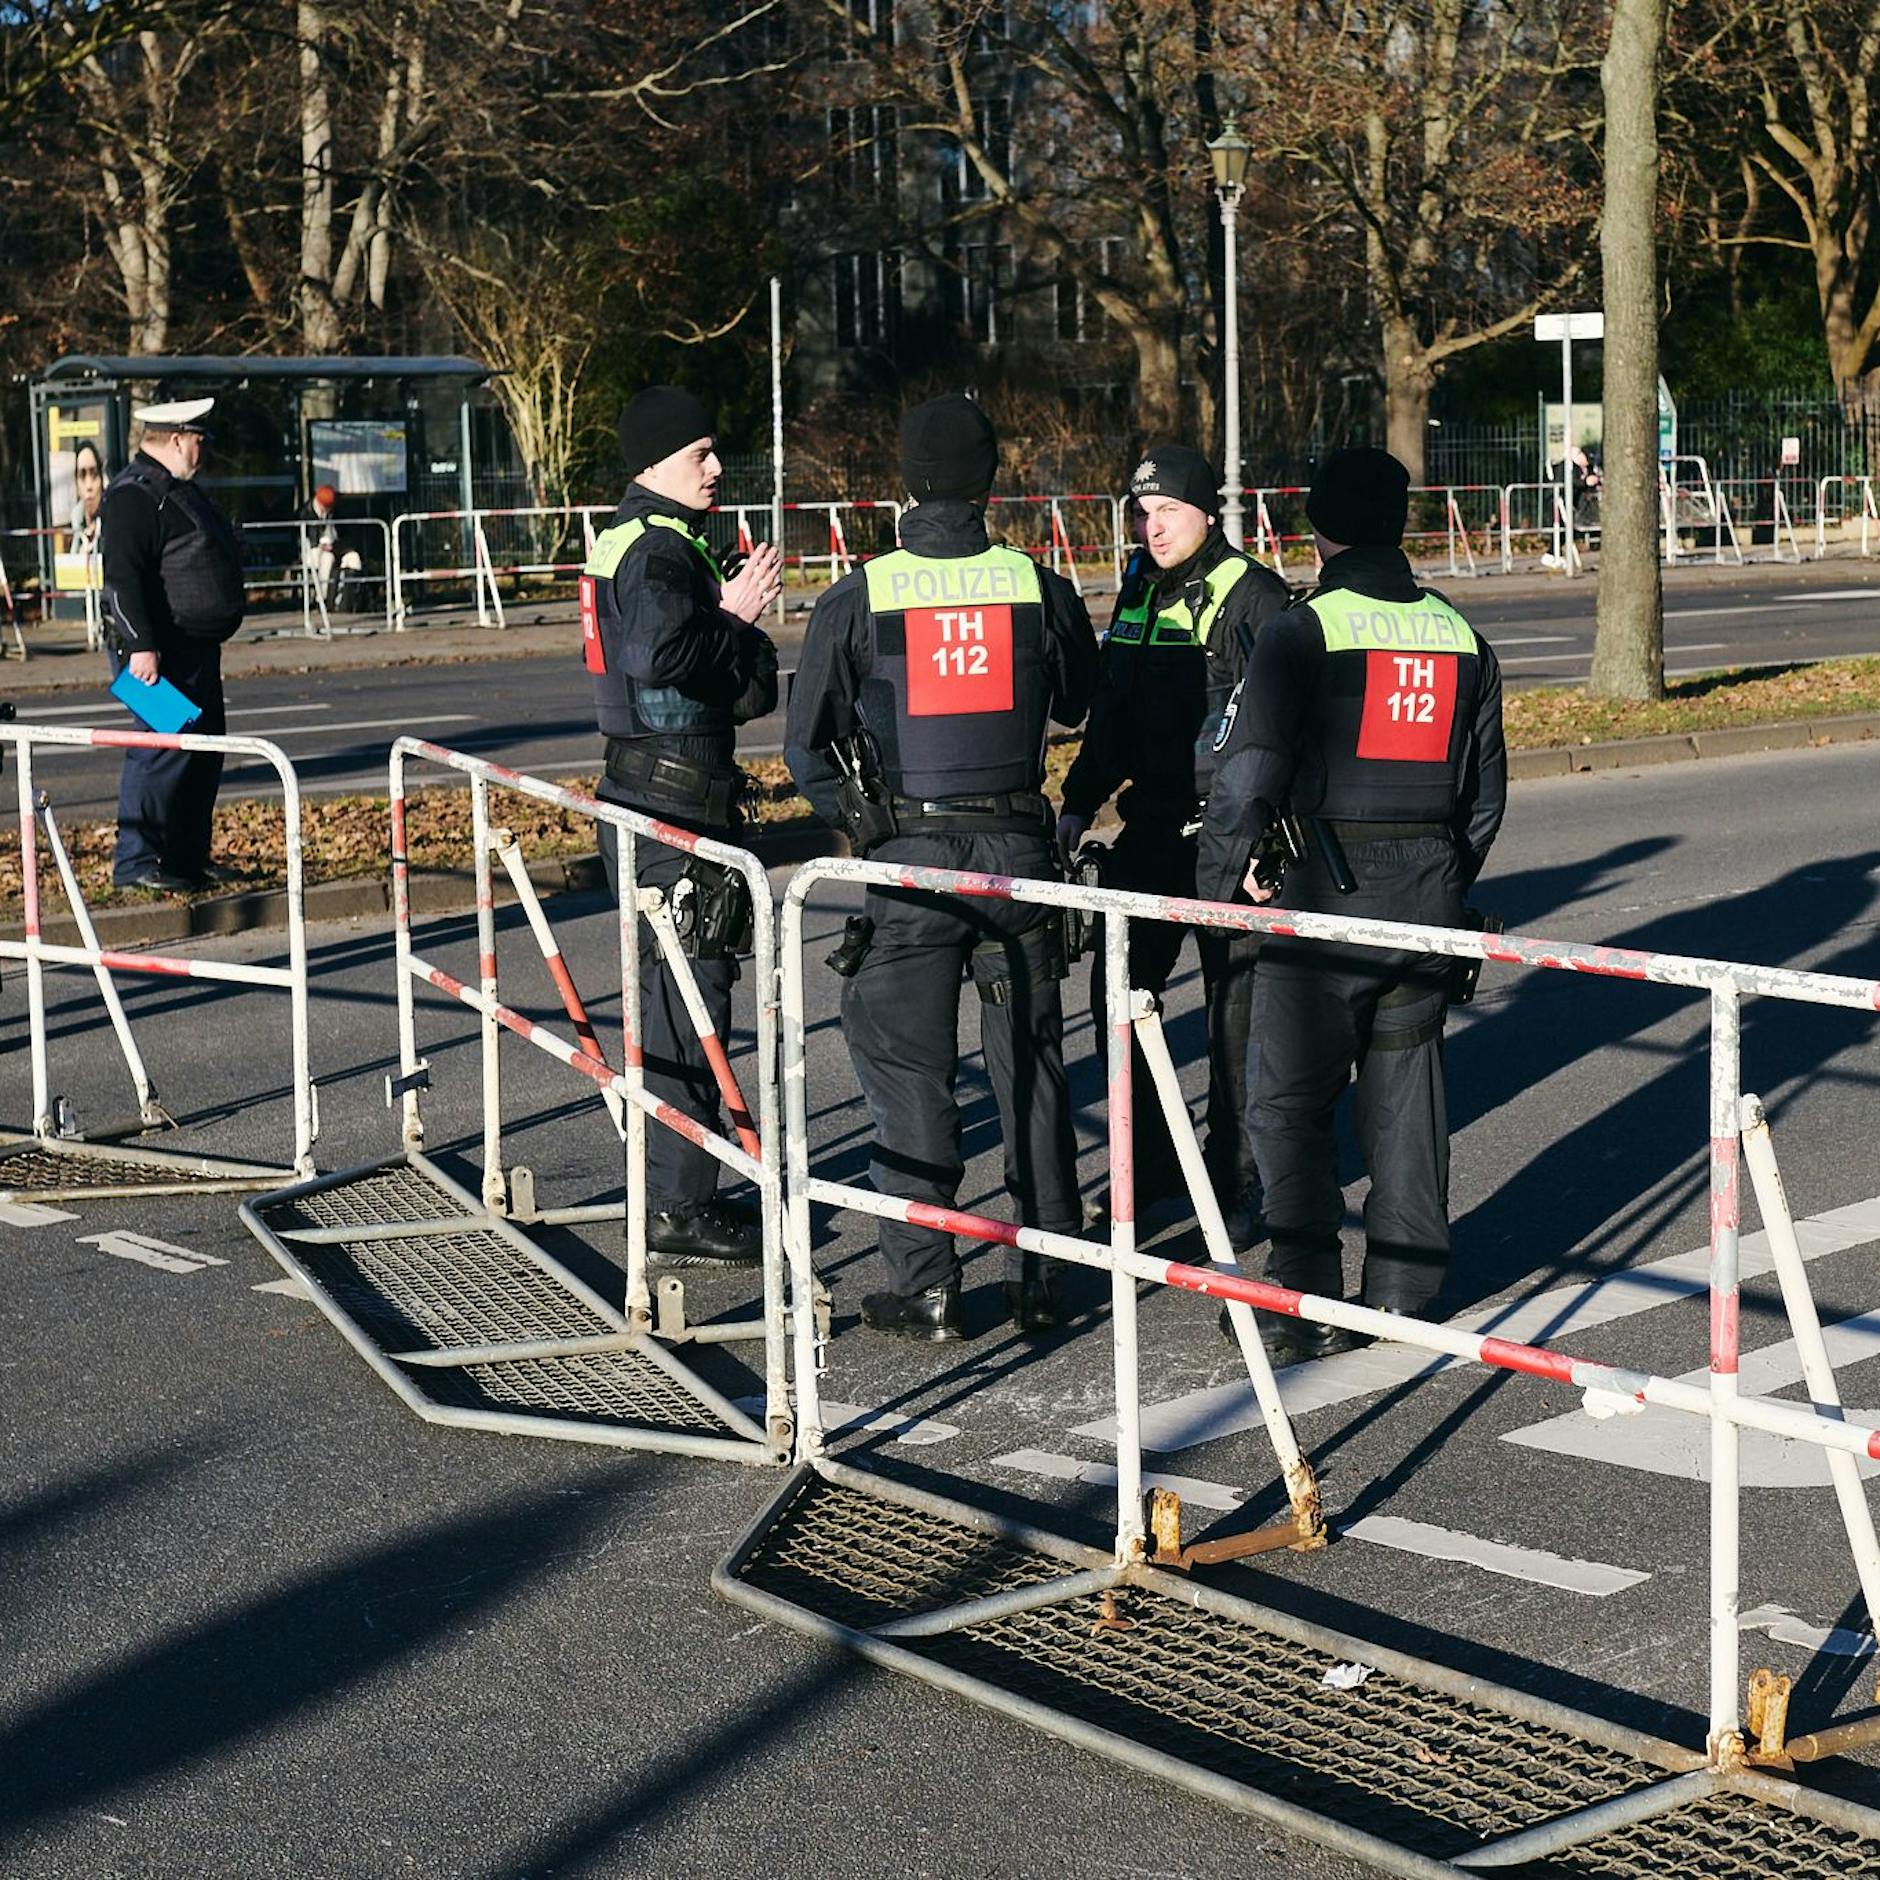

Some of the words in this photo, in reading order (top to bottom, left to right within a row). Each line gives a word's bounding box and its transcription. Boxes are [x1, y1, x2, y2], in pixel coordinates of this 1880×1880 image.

[891, 566, 1019, 603] POLIZEI
[934, 611, 984, 642] TH
[1346, 611, 1461, 646] POLIZEI
[931, 645, 989, 677] 112
[1392, 656, 1435, 689] TH
[1387, 691, 1436, 723] 112
